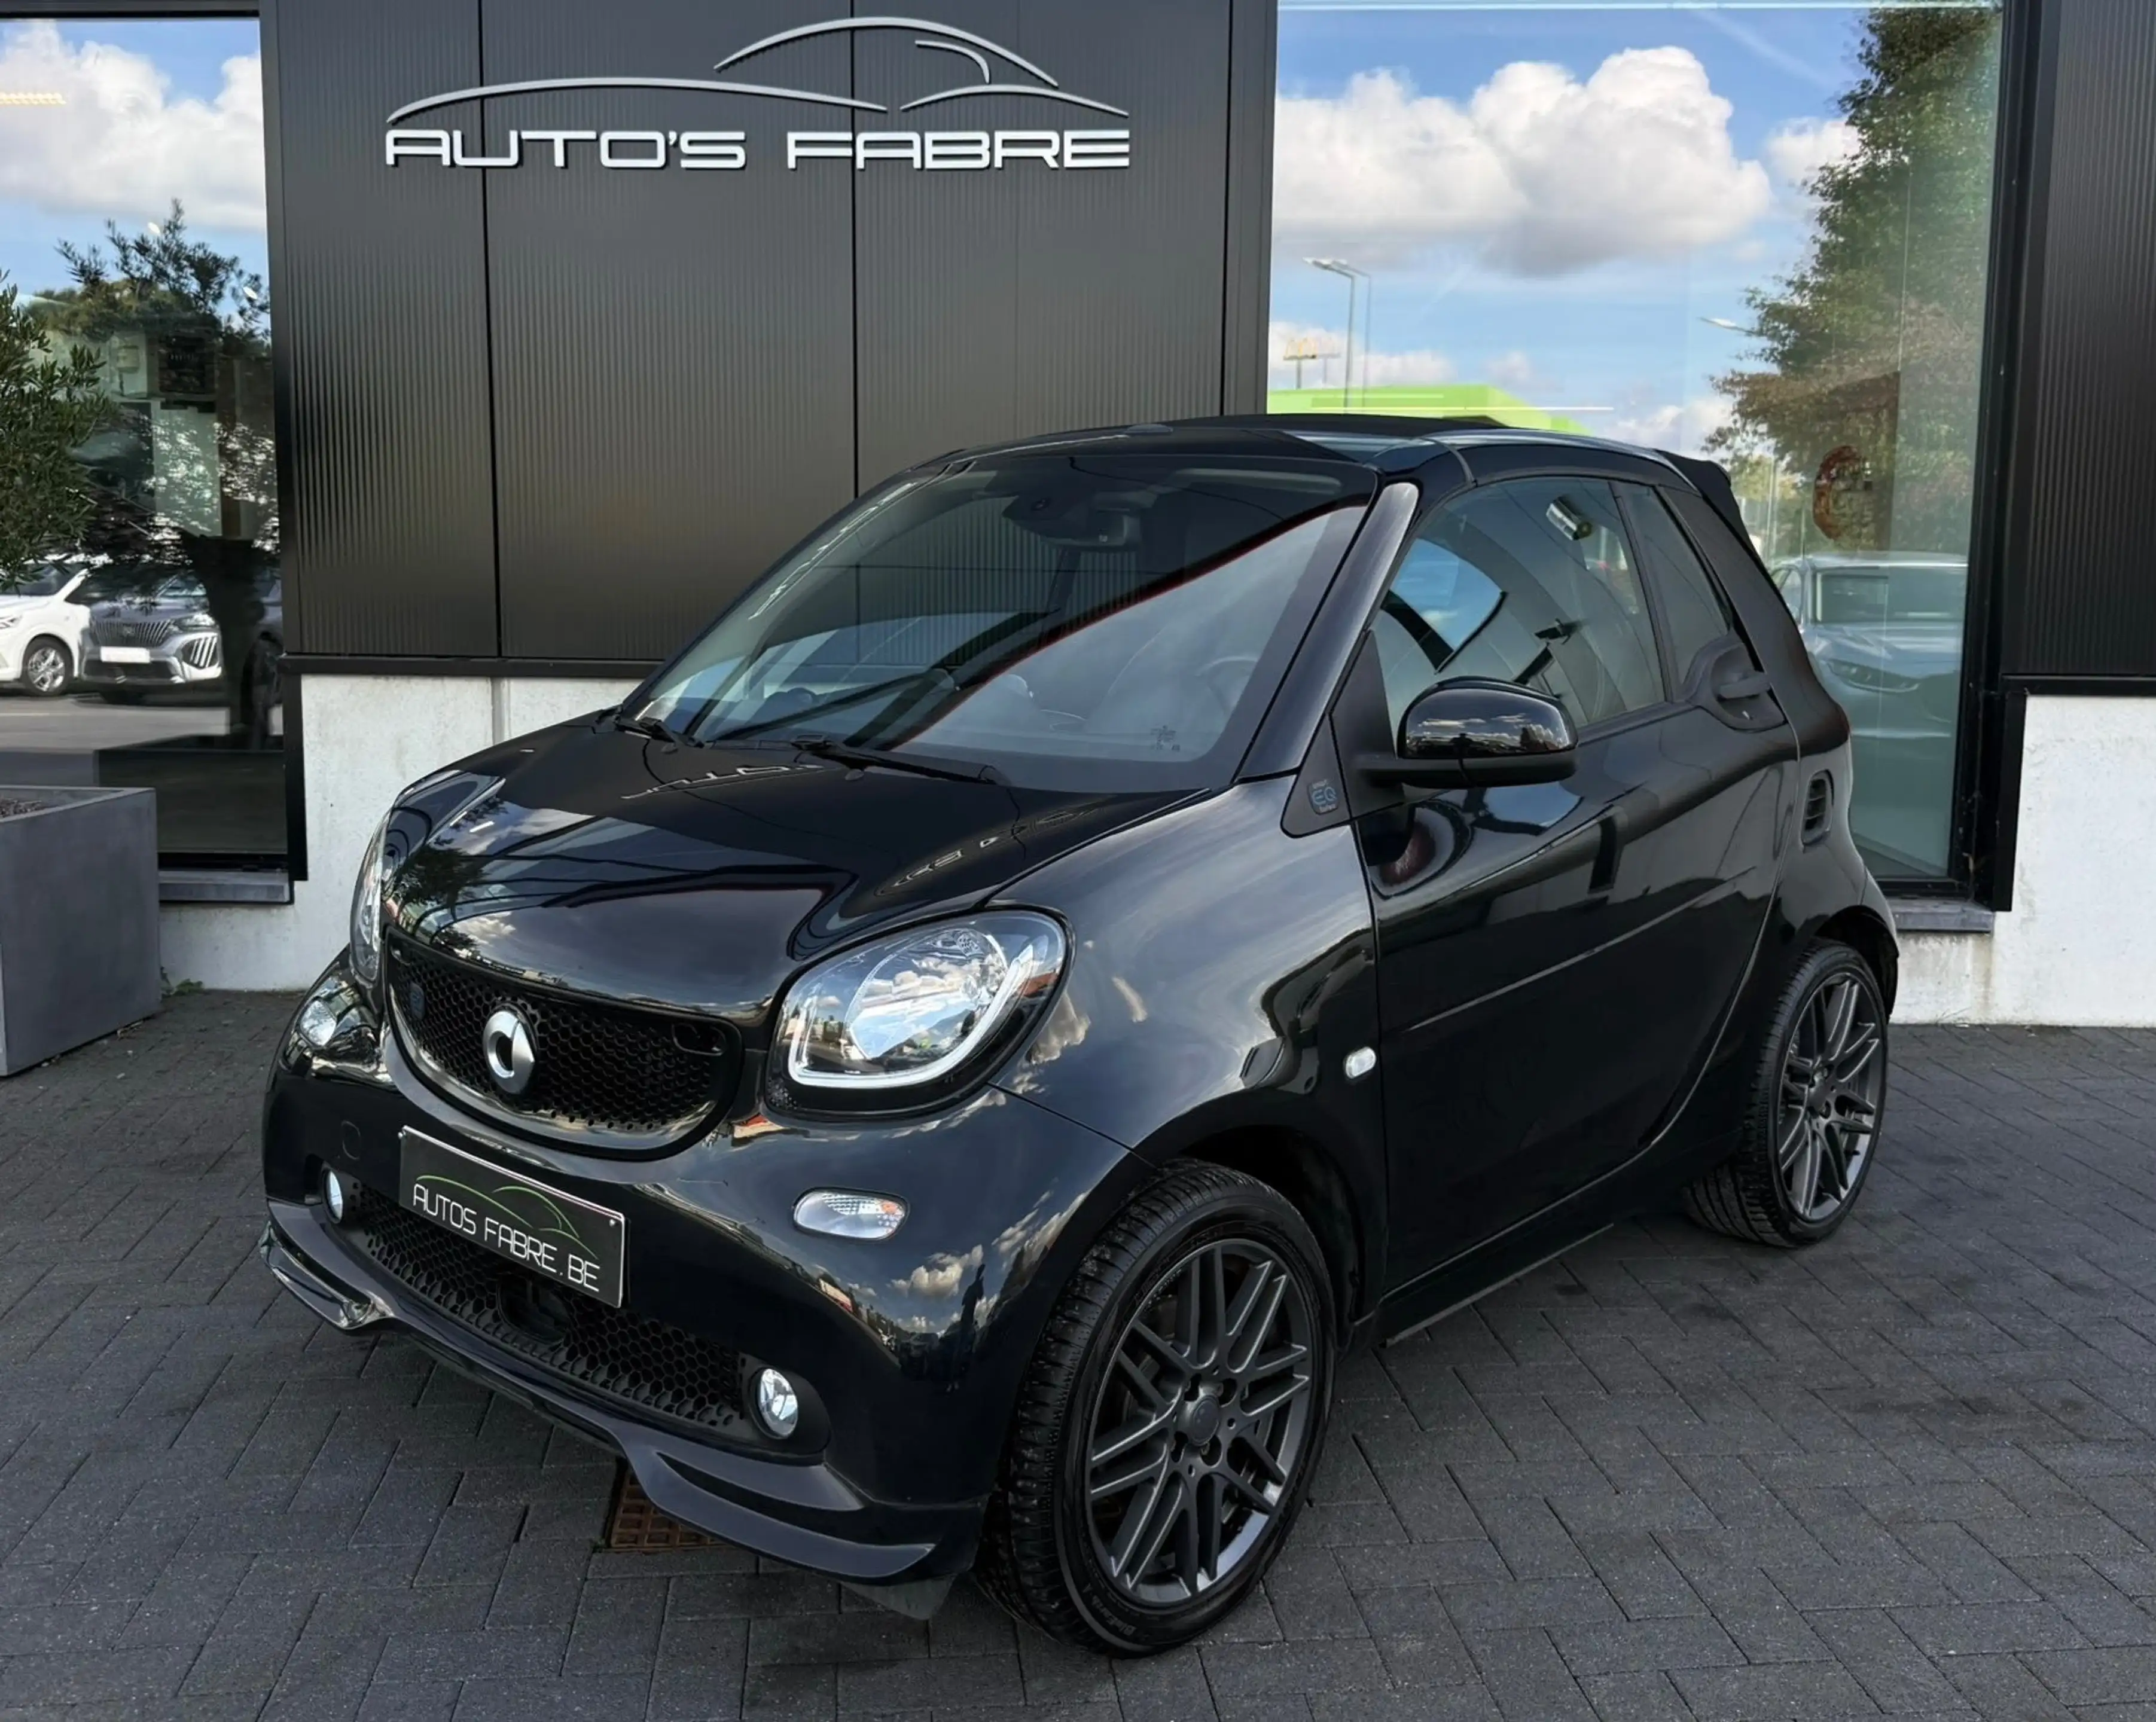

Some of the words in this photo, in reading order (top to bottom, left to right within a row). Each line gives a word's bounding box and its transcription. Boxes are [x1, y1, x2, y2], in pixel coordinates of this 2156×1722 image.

[385, 129, 746, 169] AUTO'S
[786, 129, 1130, 170] FABRE
[413, 1183, 477, 1235] AUTOS
